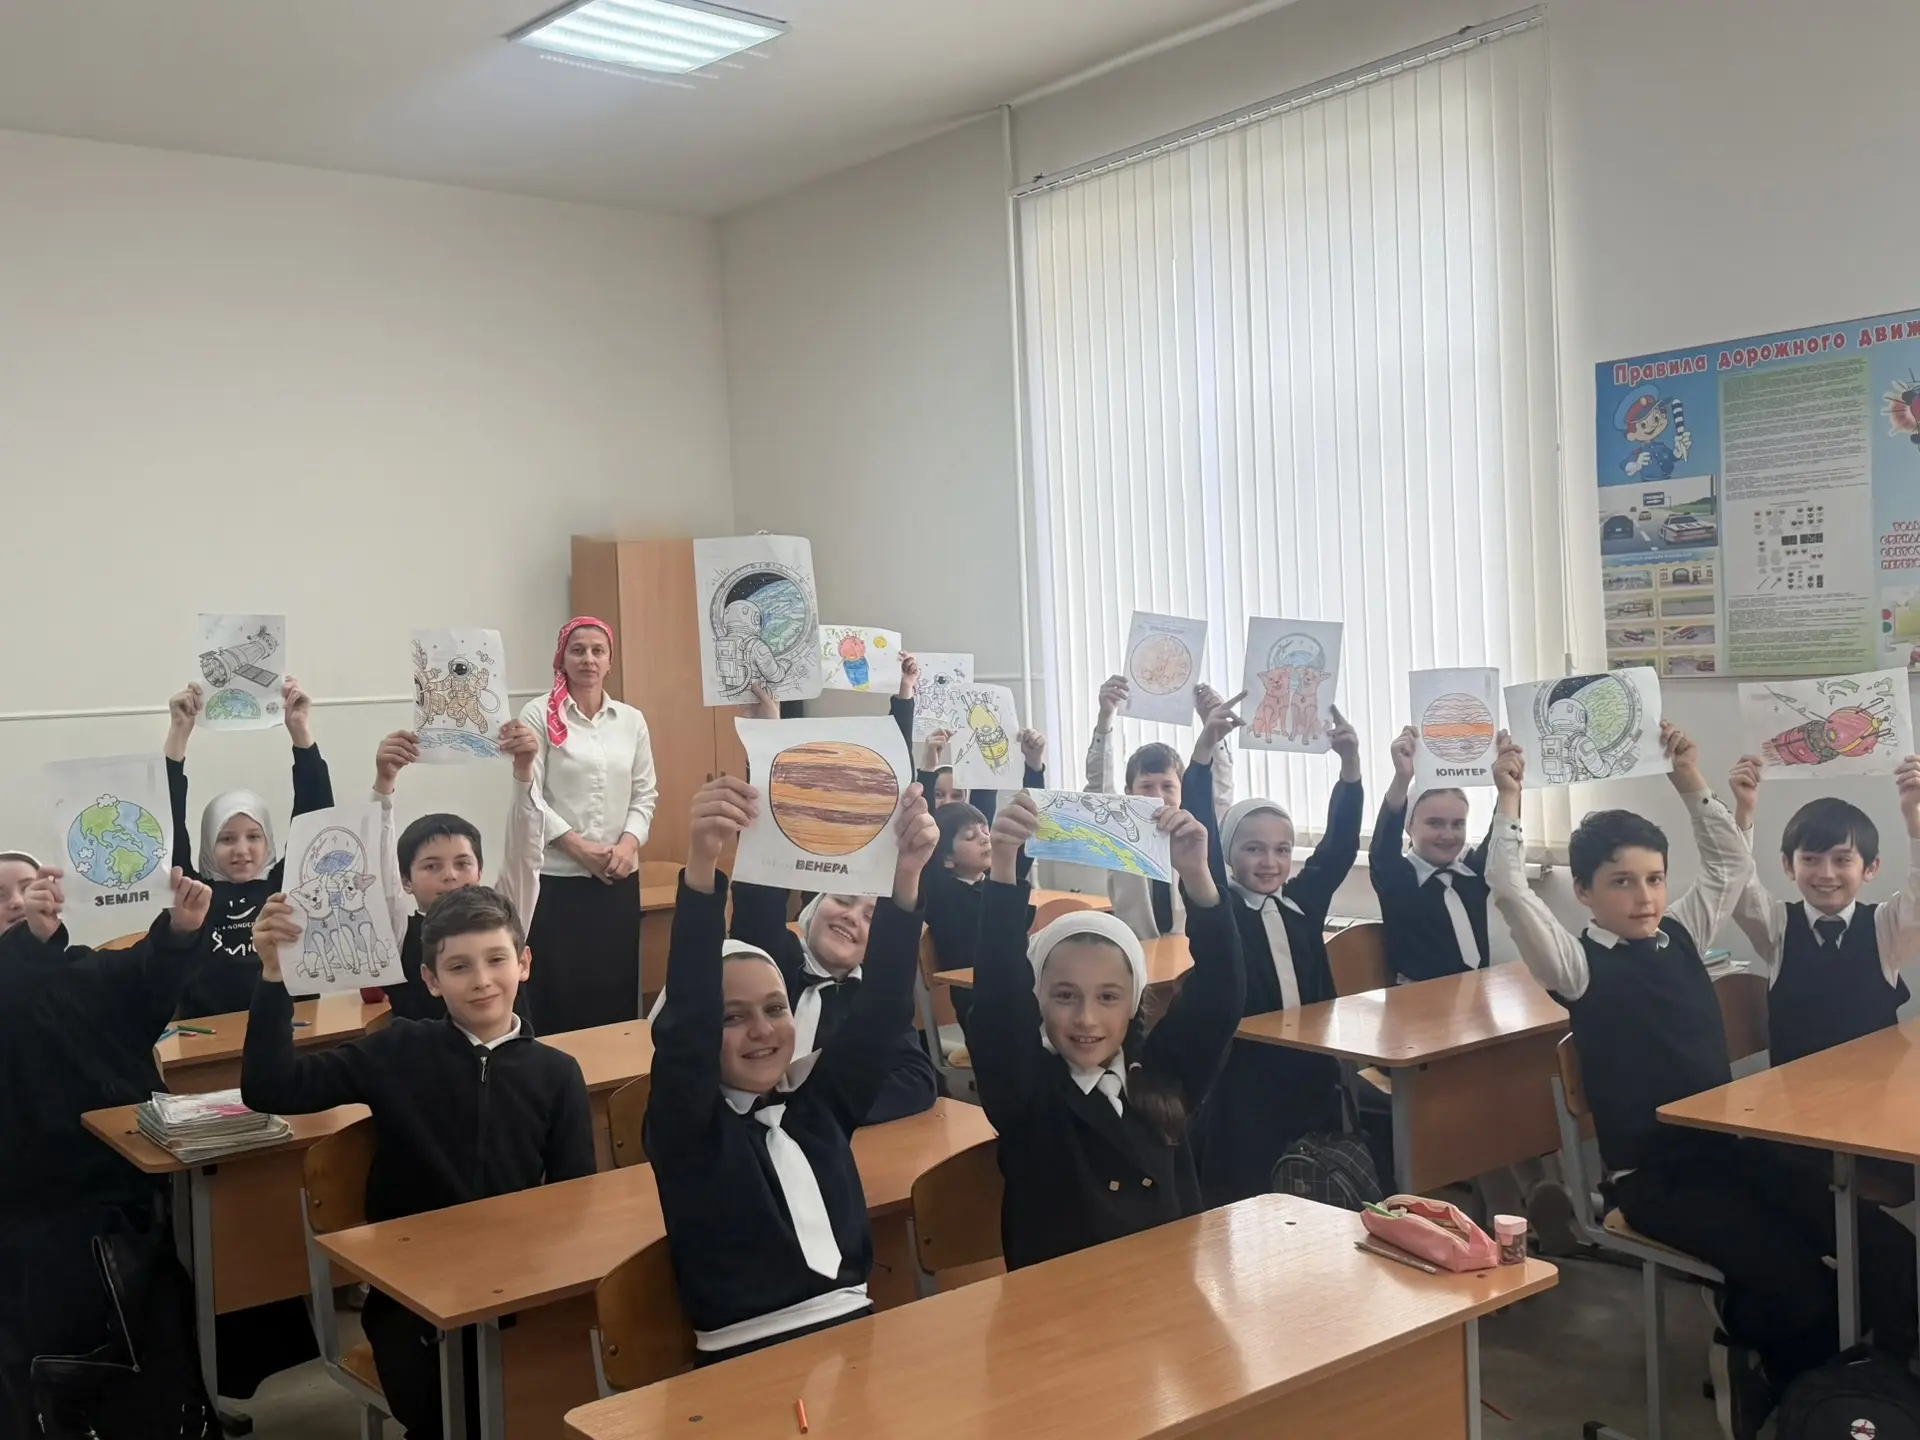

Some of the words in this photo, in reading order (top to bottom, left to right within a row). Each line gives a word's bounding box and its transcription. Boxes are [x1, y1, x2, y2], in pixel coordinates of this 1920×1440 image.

[1613, 354, 1708, 387] Правила
[1717, 331, 1846, 370] дорожного
[1435, 767, 1487, 777] ЮПИТЕР
[795, 859, 848, 874] ВЕНЕРА
[94, 890, 149, 907] ЗЕМЛЯ
